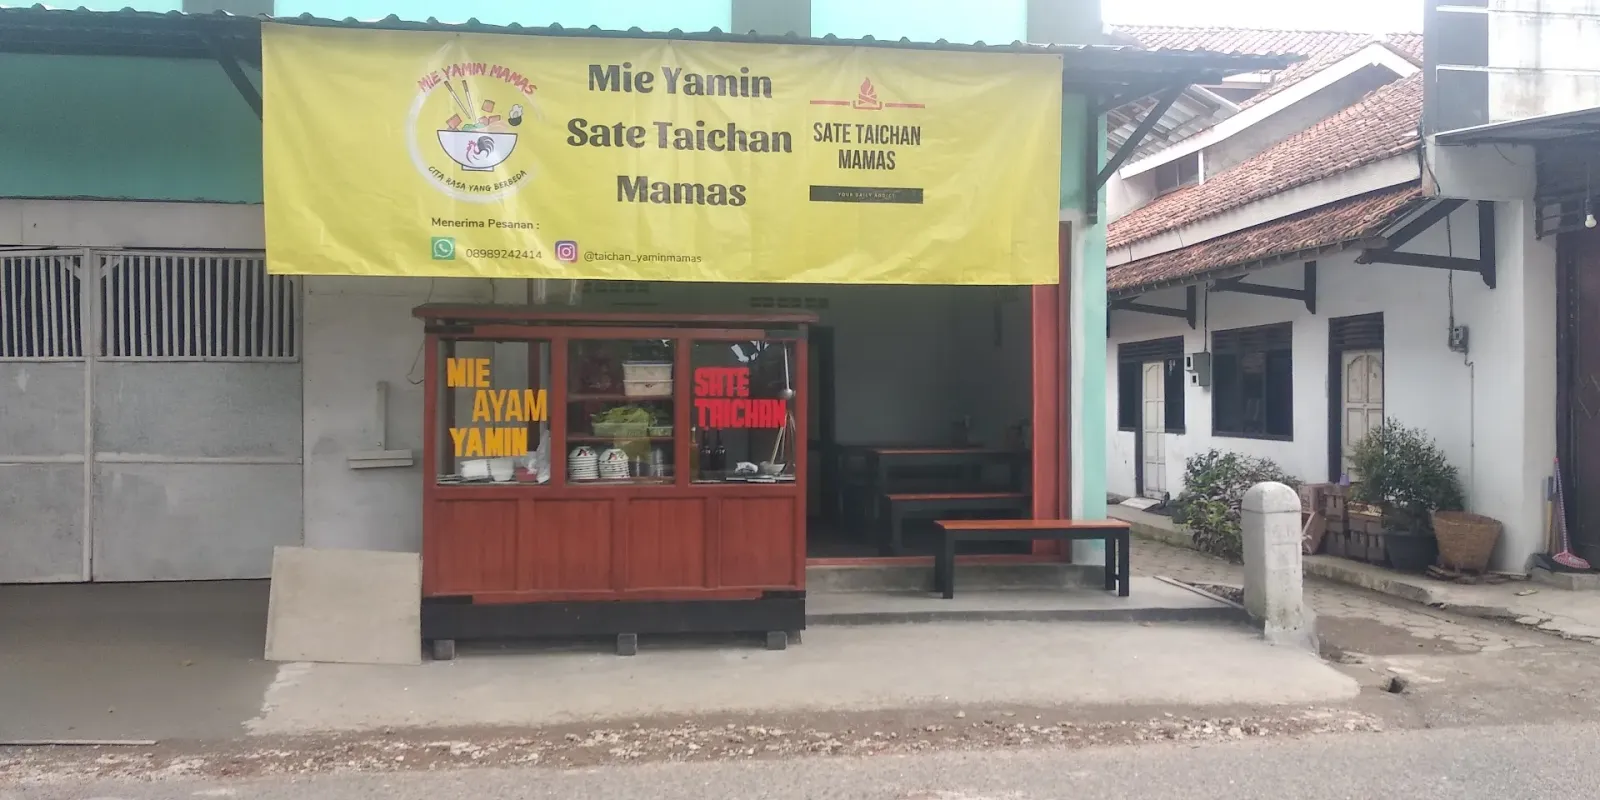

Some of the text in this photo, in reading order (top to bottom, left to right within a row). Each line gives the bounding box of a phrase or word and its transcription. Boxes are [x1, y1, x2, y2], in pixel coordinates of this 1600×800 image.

[417, 62, 538, 95] MIE YAMIN MAMAS
[588, 61, 773, 99] Mie Yamin
[566, 117, 793, 153] Sate Taichan
[813, 122, 921, 146] SATE TAICHAN
[838, 149, 896, 170] MAMAS
[428, 165, 528, 192] CITA RASA YANG BERBEDA
[616, 175, 747, 207] Mamas
[431, 217, 485, 229] Menerima
[488, 218, 534, 230] Pesanan
[465, 248, 543, 260] 08989242414
[583, 251, 702, 264] @taichan_yaminmamas
[446, 357, 491, 388] MIE
[694, 366, 750, 398] SATE
[472, 388, 548, 422] AYAM
[694, 398, 787, 429] TAICHAN
[449, 427, 528, 457] YAMIN
